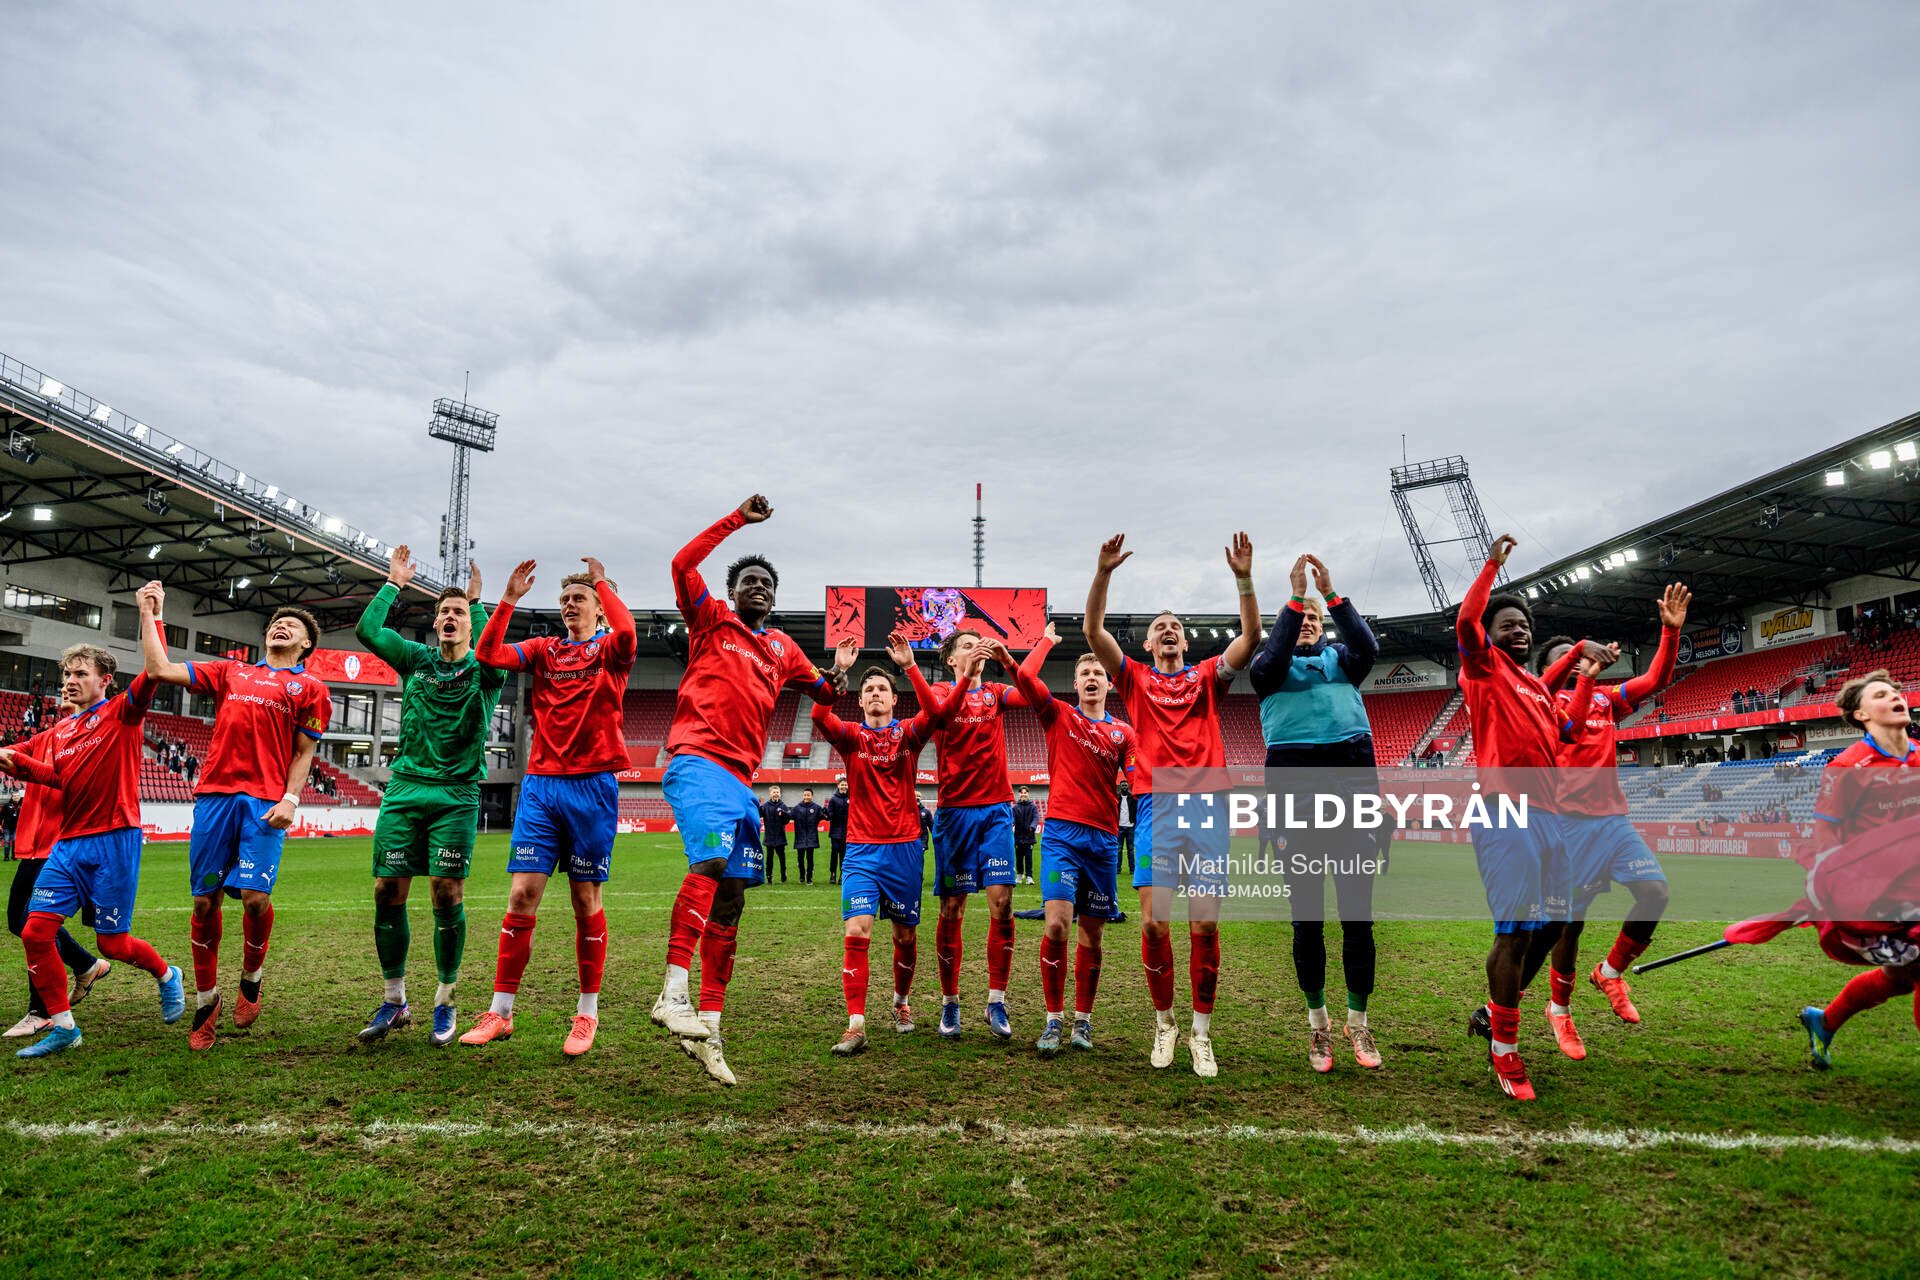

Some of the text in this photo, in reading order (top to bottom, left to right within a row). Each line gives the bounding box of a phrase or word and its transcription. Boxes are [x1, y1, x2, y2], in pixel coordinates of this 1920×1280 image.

[1761, 609, 1814, 641] WALLIN
[1374, 675, 1430, 686] ANDERSSONS
[265, 699, 291, 714] group
[76, 736, 101, 752] group
[1394, 771, 1453, 780] FLAGGA.COM
[515, 846, 534, 855] Solid
[1657, 838, 1675, 852] BOKA
[1675, 839, 1694, 853] BORD
[1700, 840, 1748, 855] SPORTBAREN
[386, 851, 405, 860] Solid
[437, 847, 461, 859] Fibio
[743, 847, 764, 860] Fibio
[570, 854, 592, 868] Fibio
[988, 858, 1009, 868] Fibio
[1628, 857, 1656, 871] Fibio
[269, 864, 275, 874] 2
[955, 873, 973, 882] Solid
[33, 888, 54, 898] Solid
[1087, 890, 1110, 902] Fibio
[850, 896, 868, 905] Solid
